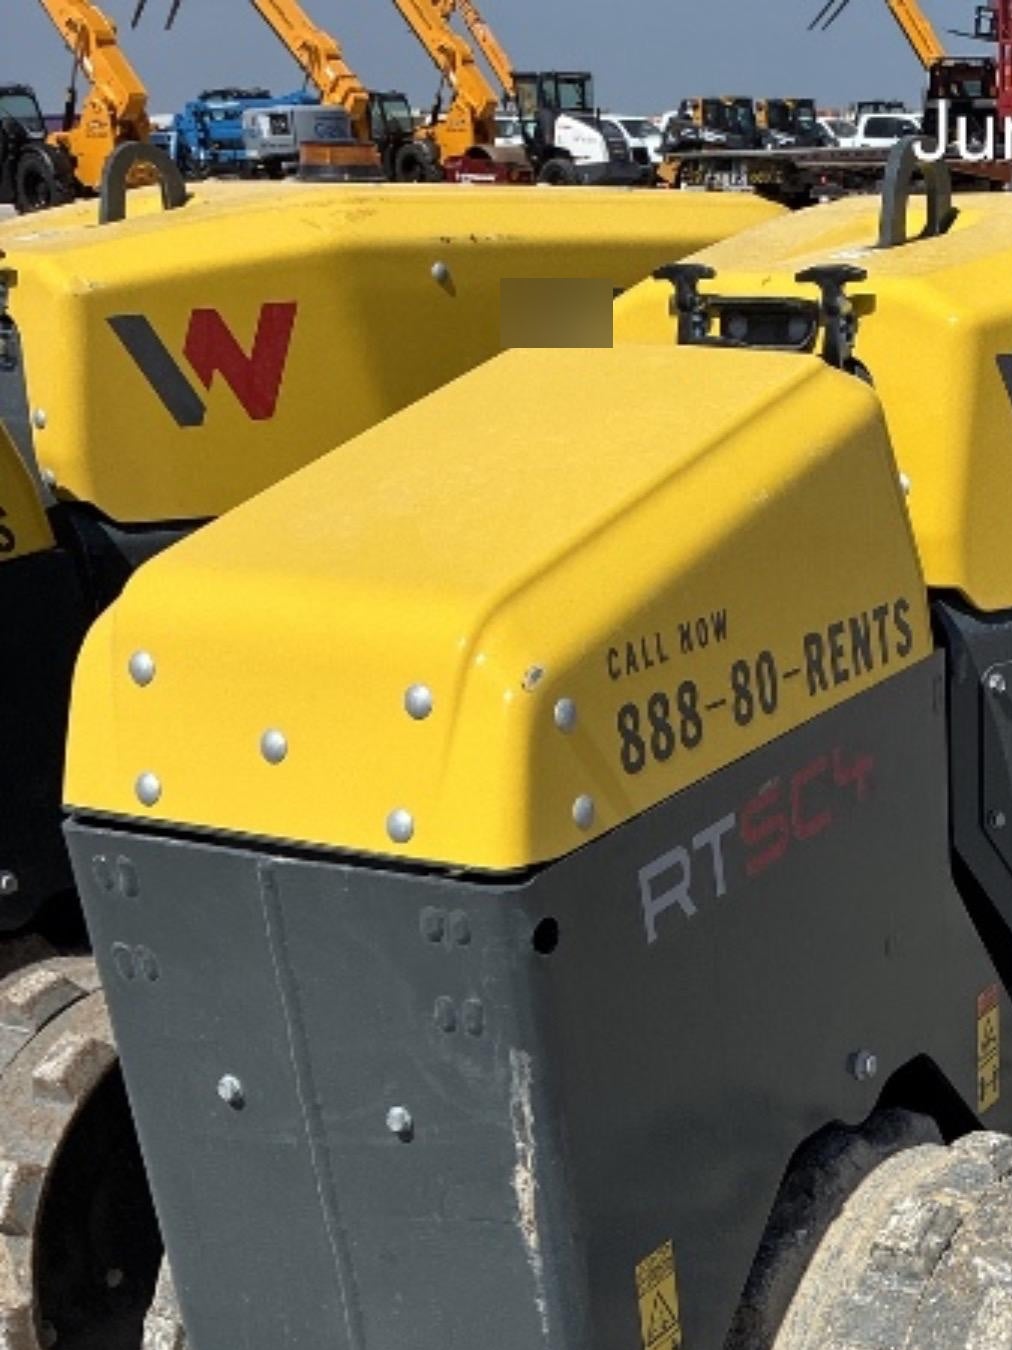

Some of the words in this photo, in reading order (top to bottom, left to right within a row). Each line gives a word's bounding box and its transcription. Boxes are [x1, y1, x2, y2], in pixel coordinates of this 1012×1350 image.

[606, 631, 670, 681] CALL
[677, 607, 729, 656] NOW
[617, 596, 915, 776] 888-80-RENTS
